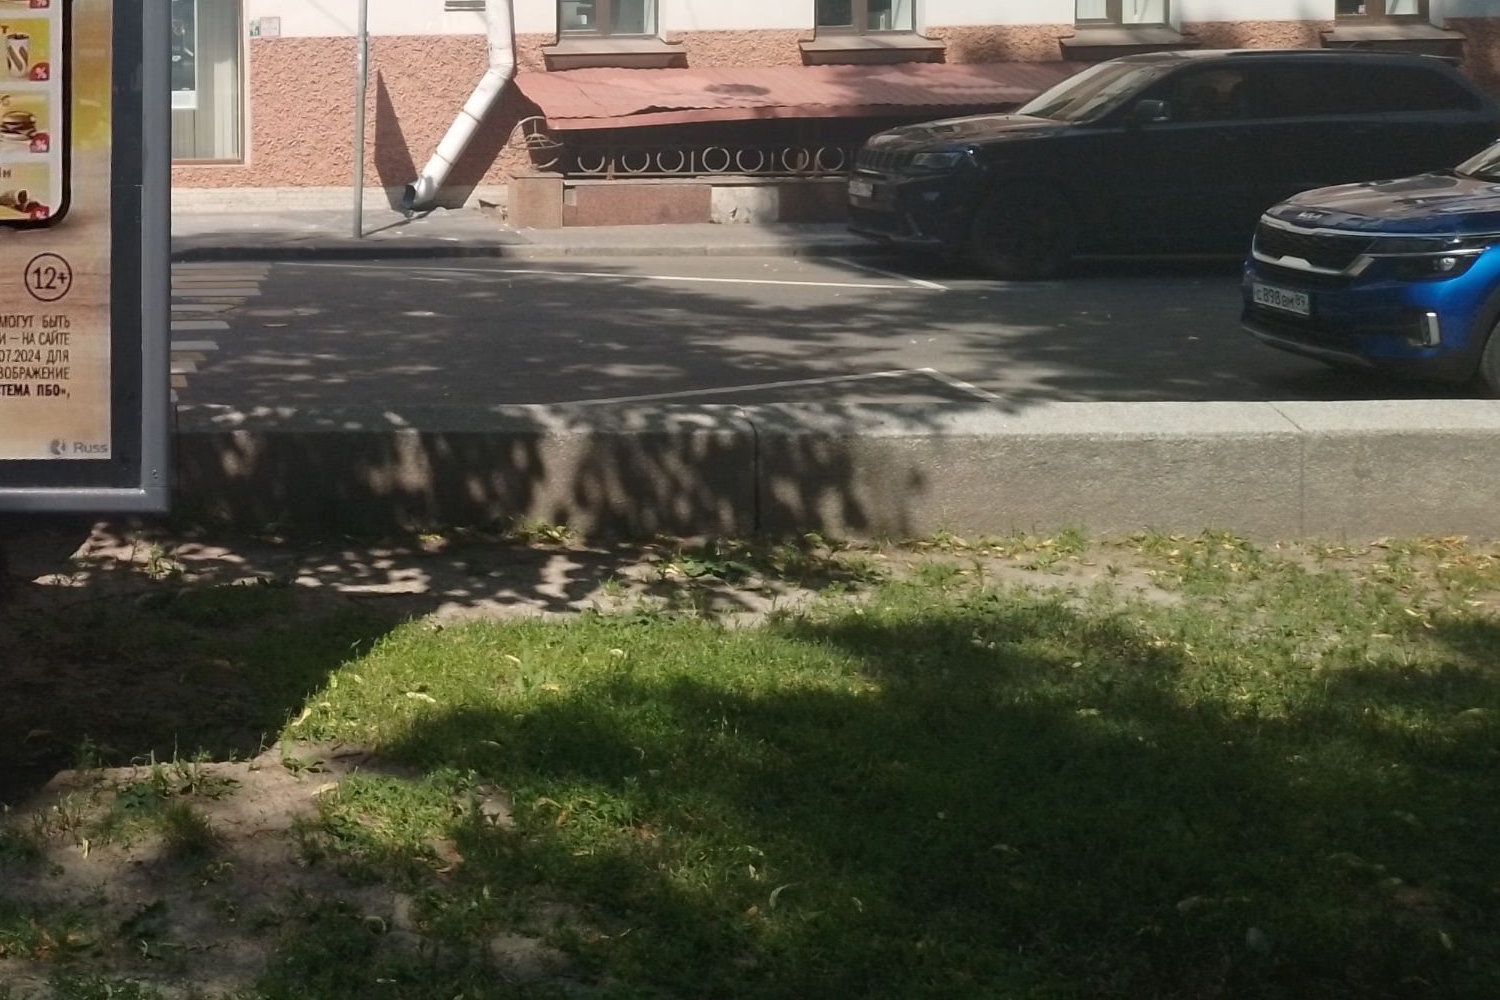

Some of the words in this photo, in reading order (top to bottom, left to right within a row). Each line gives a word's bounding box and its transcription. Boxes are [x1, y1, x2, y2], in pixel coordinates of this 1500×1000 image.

[31, 266, 68, 290] 12+
[41, 312, 71, 328] БЫТЬ
[21, 330, 36, 346] НА
[38, 329, 71, 345] САЙТЕ
[45, 346, 70, 362] ДЛЯ
[73, 441, 108, 454] Russ
